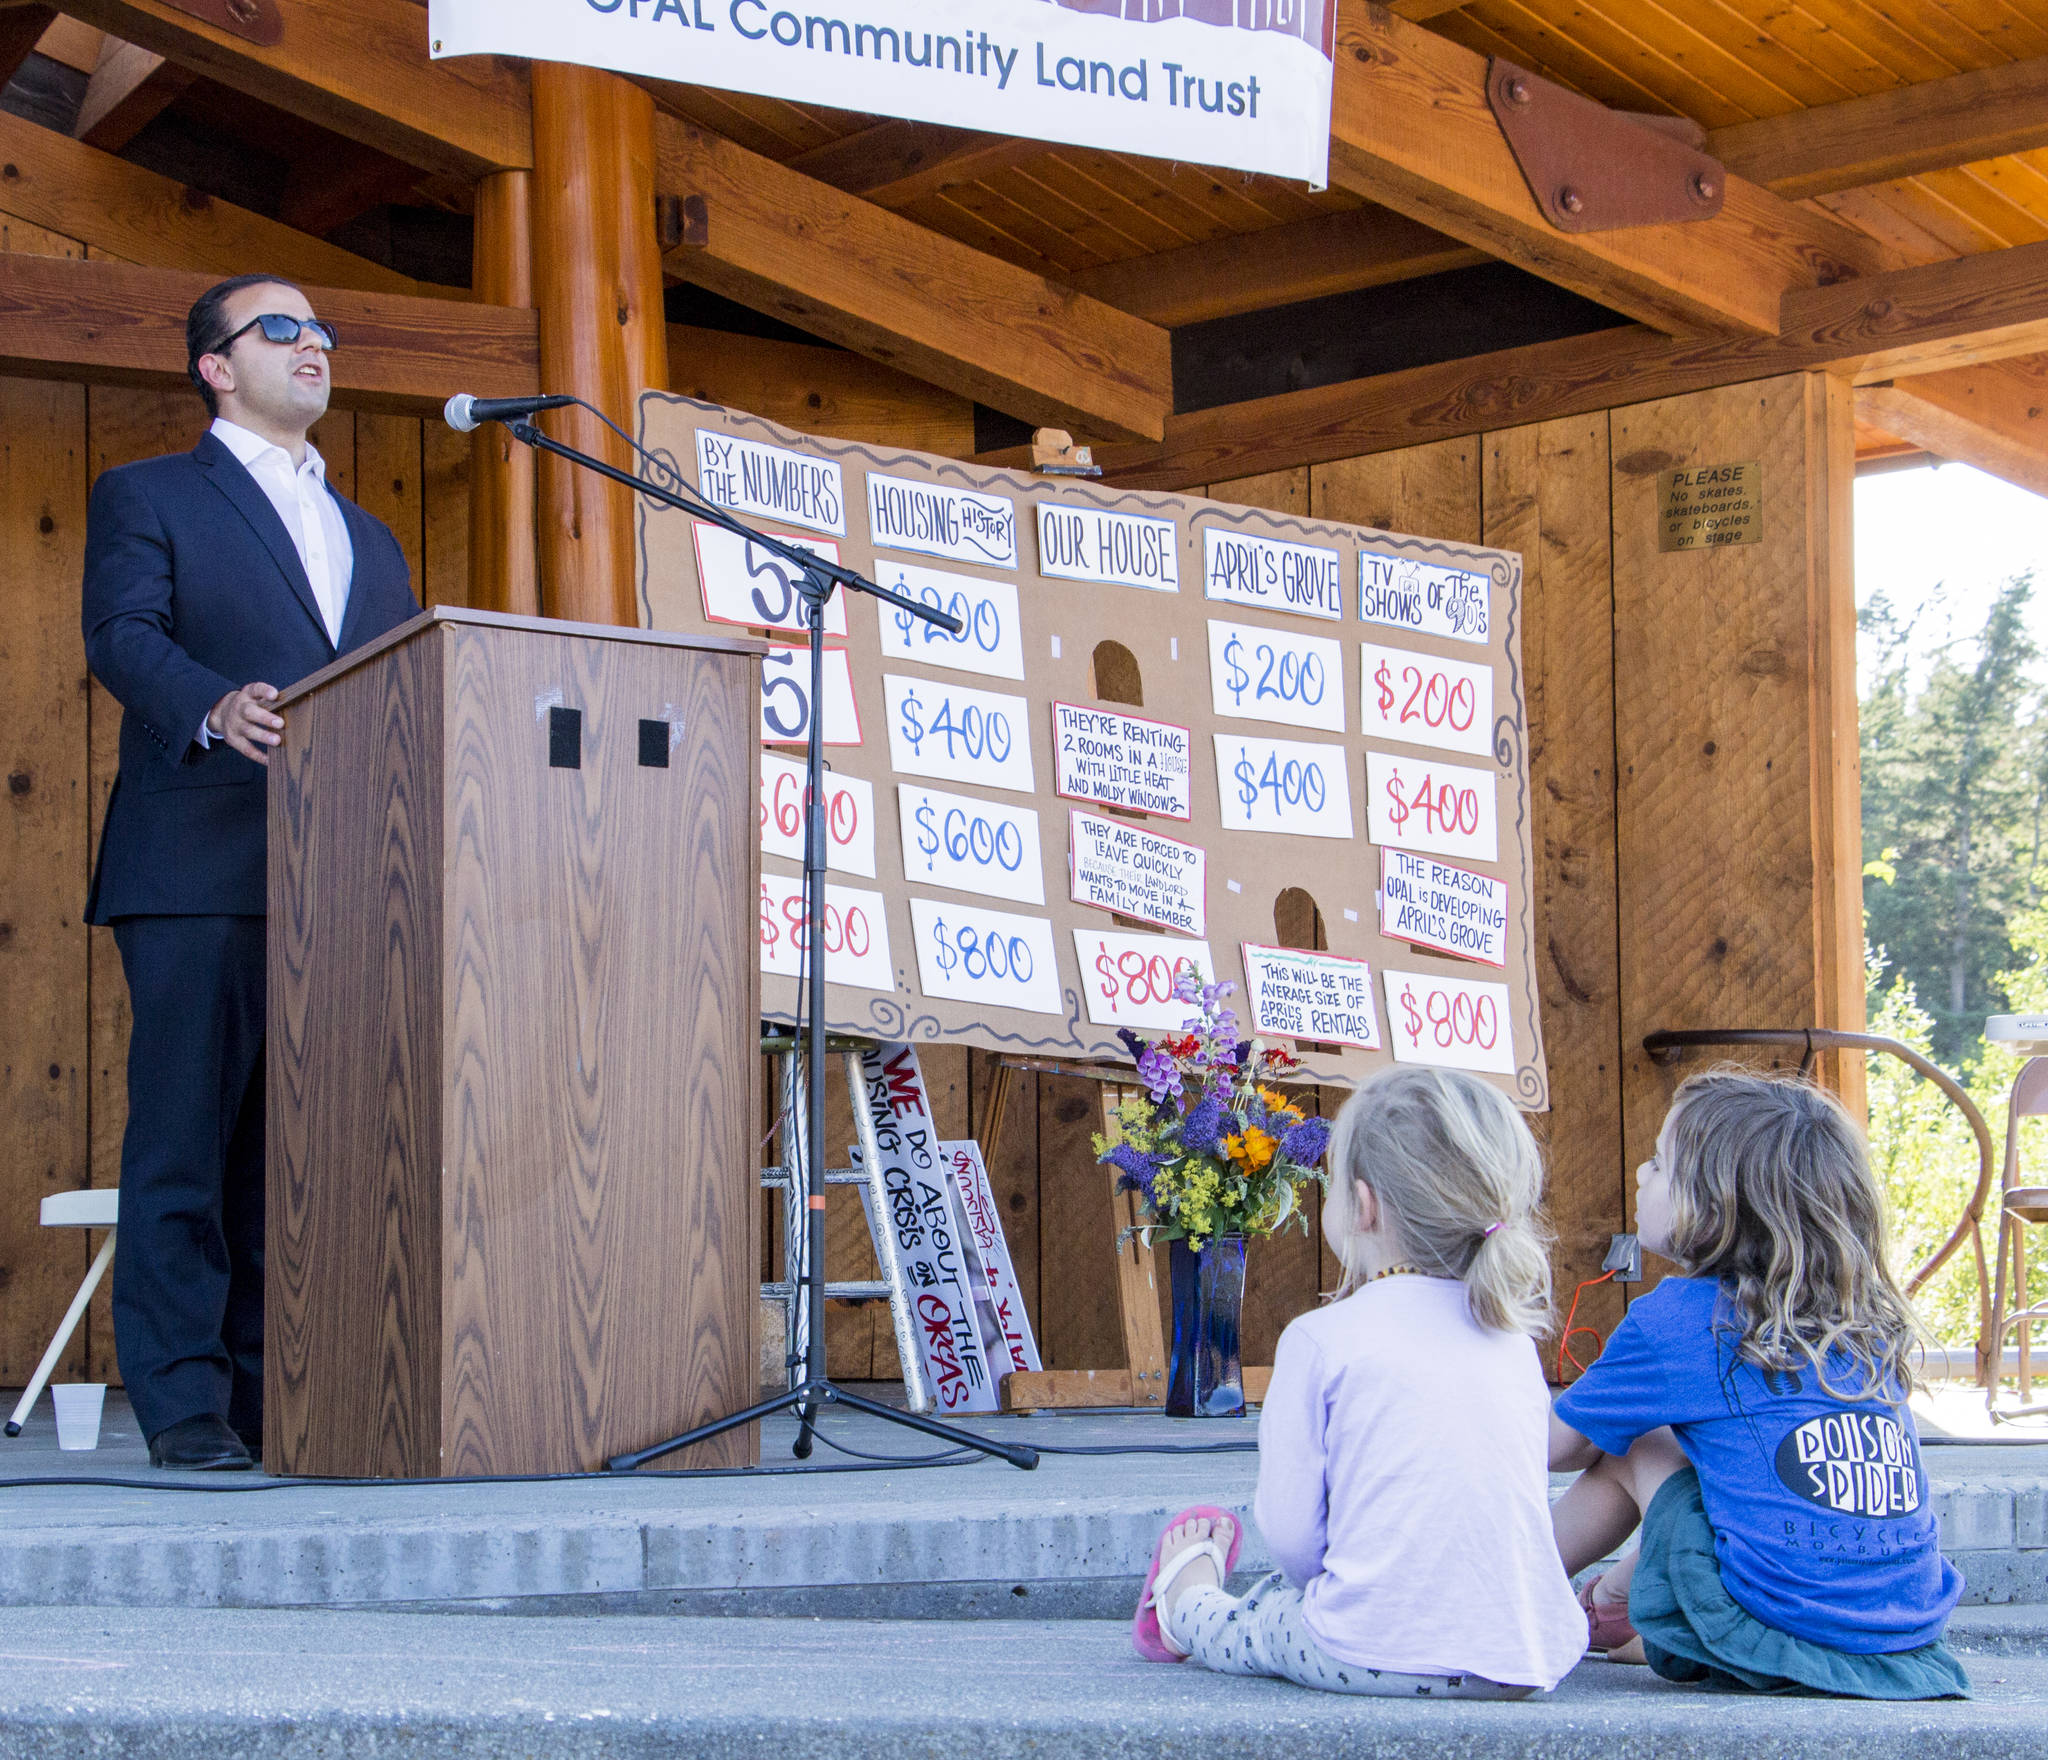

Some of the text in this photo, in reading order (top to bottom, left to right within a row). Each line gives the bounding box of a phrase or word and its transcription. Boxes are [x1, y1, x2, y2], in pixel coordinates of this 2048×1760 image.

[729, 0, 1018, 89] Community
[1036, 42, 1148, 101] Land
[1162, 62, 1261, 118] Trust
[704, 437, 733, 469] BY
[704, 450, 839, 525] THE NUMBERS
[1670, 491, 1689, 503] No
[1672, 466, 1745, 488] PLEASE
[874, 483, 1013, 548] HOUSING HISTORY
[1669, 514, 1751, 533] or bicycles
[1677, 530, 1743, 546] on stage
[1044, 511, 1176, 584] OUR HOUSE
[1210, 541, 1340, 612] APRIL'S GROVE
[1368, 560, 1393, 586] TV
[892, 572, 1000, 652] $200
[1365, 585, 1422, 625] SHOWS
[1427, 582, 1445, 611] OF
[1224, 633, 1324, 706] $200
[1374, 659, 1475, 731] $200
[901, 688, 1011, 763] $400
[1059, 708, 1186, 753] THEY'RE RENTING
[1063, 733, 1076, 752] 2
[1078, 737, 1124, 762] ROOMS
[1147, 752, 1158, 769] A
[1075, 757, 1175, 791] WITH LITTLE HEAT
[1067, 774, 1185, 813] AND MOLDY WINDOWS
[1234, 746, 1325, 820] $400
[1386, 768, 1478, 837] $400
[915, 797, 1023, 871] $600
[1081, 820, 1197, 865] THEY ARE FORCED TO
[1083, 856, 1116, 876] BECAUSE
[1145, 873, 1188, 896] LANDLORD
[1095, 840, 1183, 881] LEAVE QUICKLY
[1396, 853, 1493, 899] THE REASON
[1079, 869, 1113, 889] WANTS
[1114, 879, 1127, 892] TO
[1128, 883, 1159, 902] MOVE
[1176, 898, 1195, 911] A
[1090, 885, 1197, 932] FAMILY MEMBER
[1387, 876, 1417, 904] OPAL
[1430, 890, 1506, 929] DEVELOPING
[934, 917, 1033, 982] $800
[1396, 904, 1494, 954] APRIL'S GROVE
[1261, 962, 1364, 992] THIS WILL BE THE
[1261, 980, 1365, 1010] AVERAGE SIZE OF
[1260, 1000, 1302, 1020] APRIL'S
[1261, 1009, 1370, 1040] GROVE RENTALS
[1400, 983, 1497, 1050] $800
[862, 1050, 969, 1408] USING CRISIS ON ORCAS
[883, 1045, 984, 1389] WE DO ABOUT THE
[1795, 1413, 1914, 1467] POISON
[1807, 1461, 1919, 1516] SPIDER
